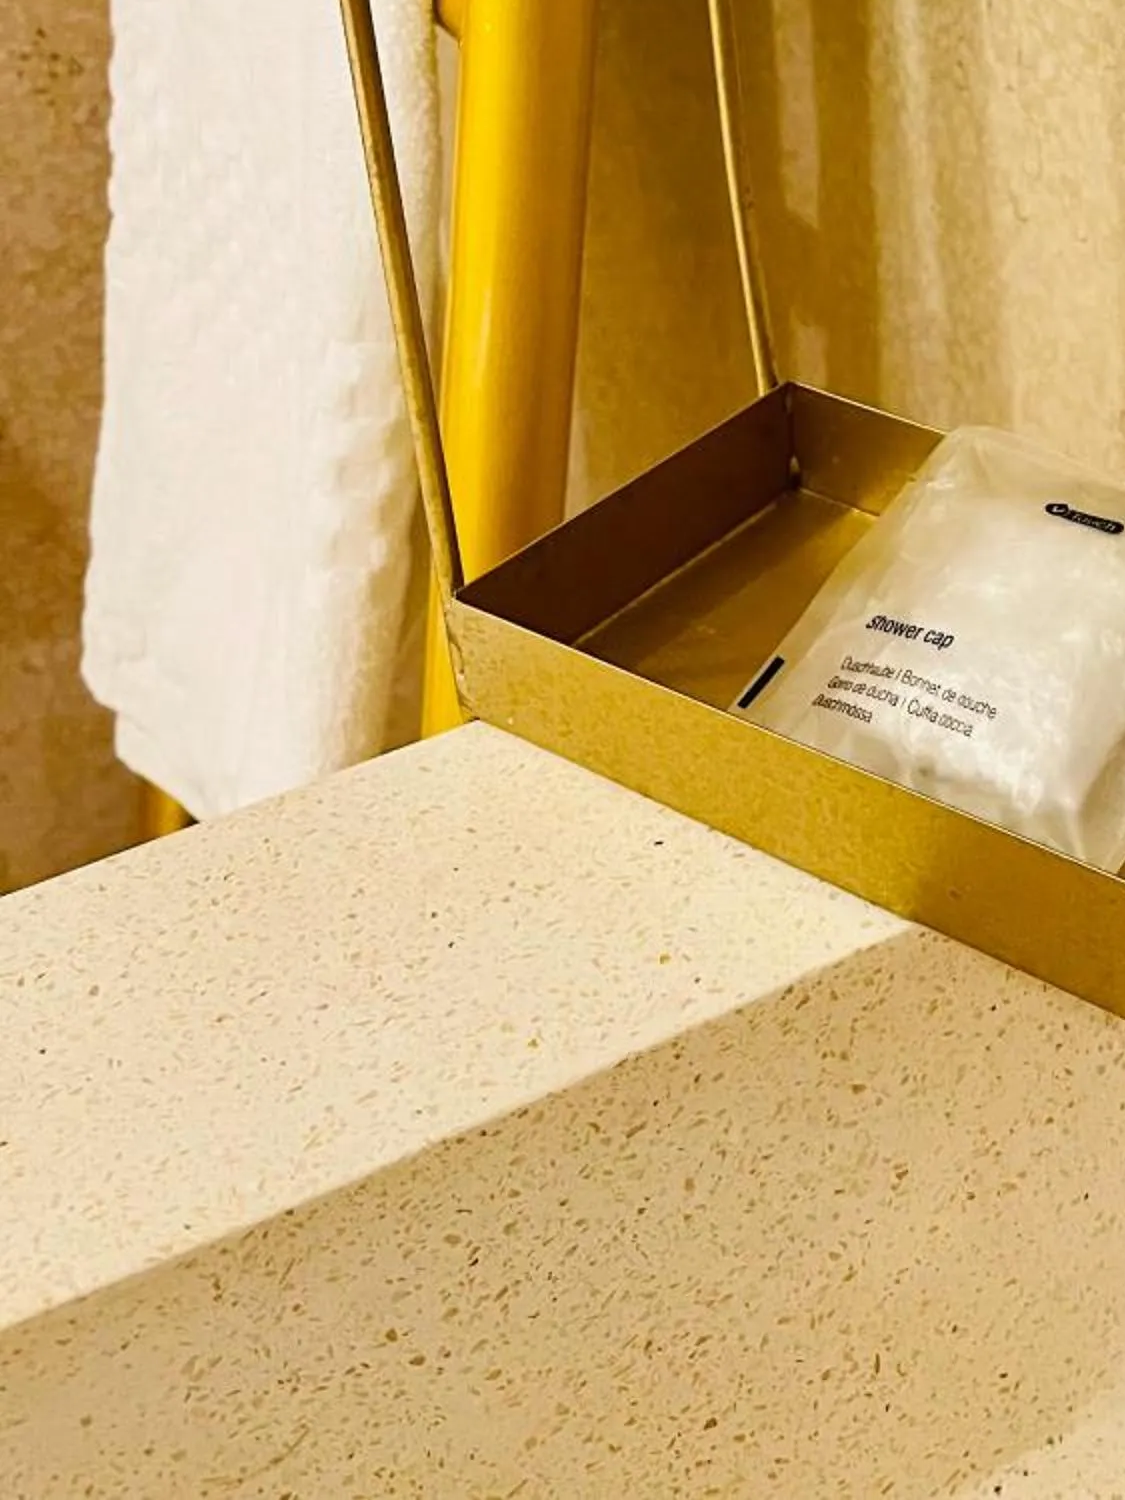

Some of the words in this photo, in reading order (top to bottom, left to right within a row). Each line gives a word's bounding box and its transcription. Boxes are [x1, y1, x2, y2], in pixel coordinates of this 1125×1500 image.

[865, 614, 923, 641] shower
[923, 627, 955, 650] cap
[901, 668, 941, 696] Bonnet
[942, 688, 957, 703] de
[958, 694, 997, 720] douche
